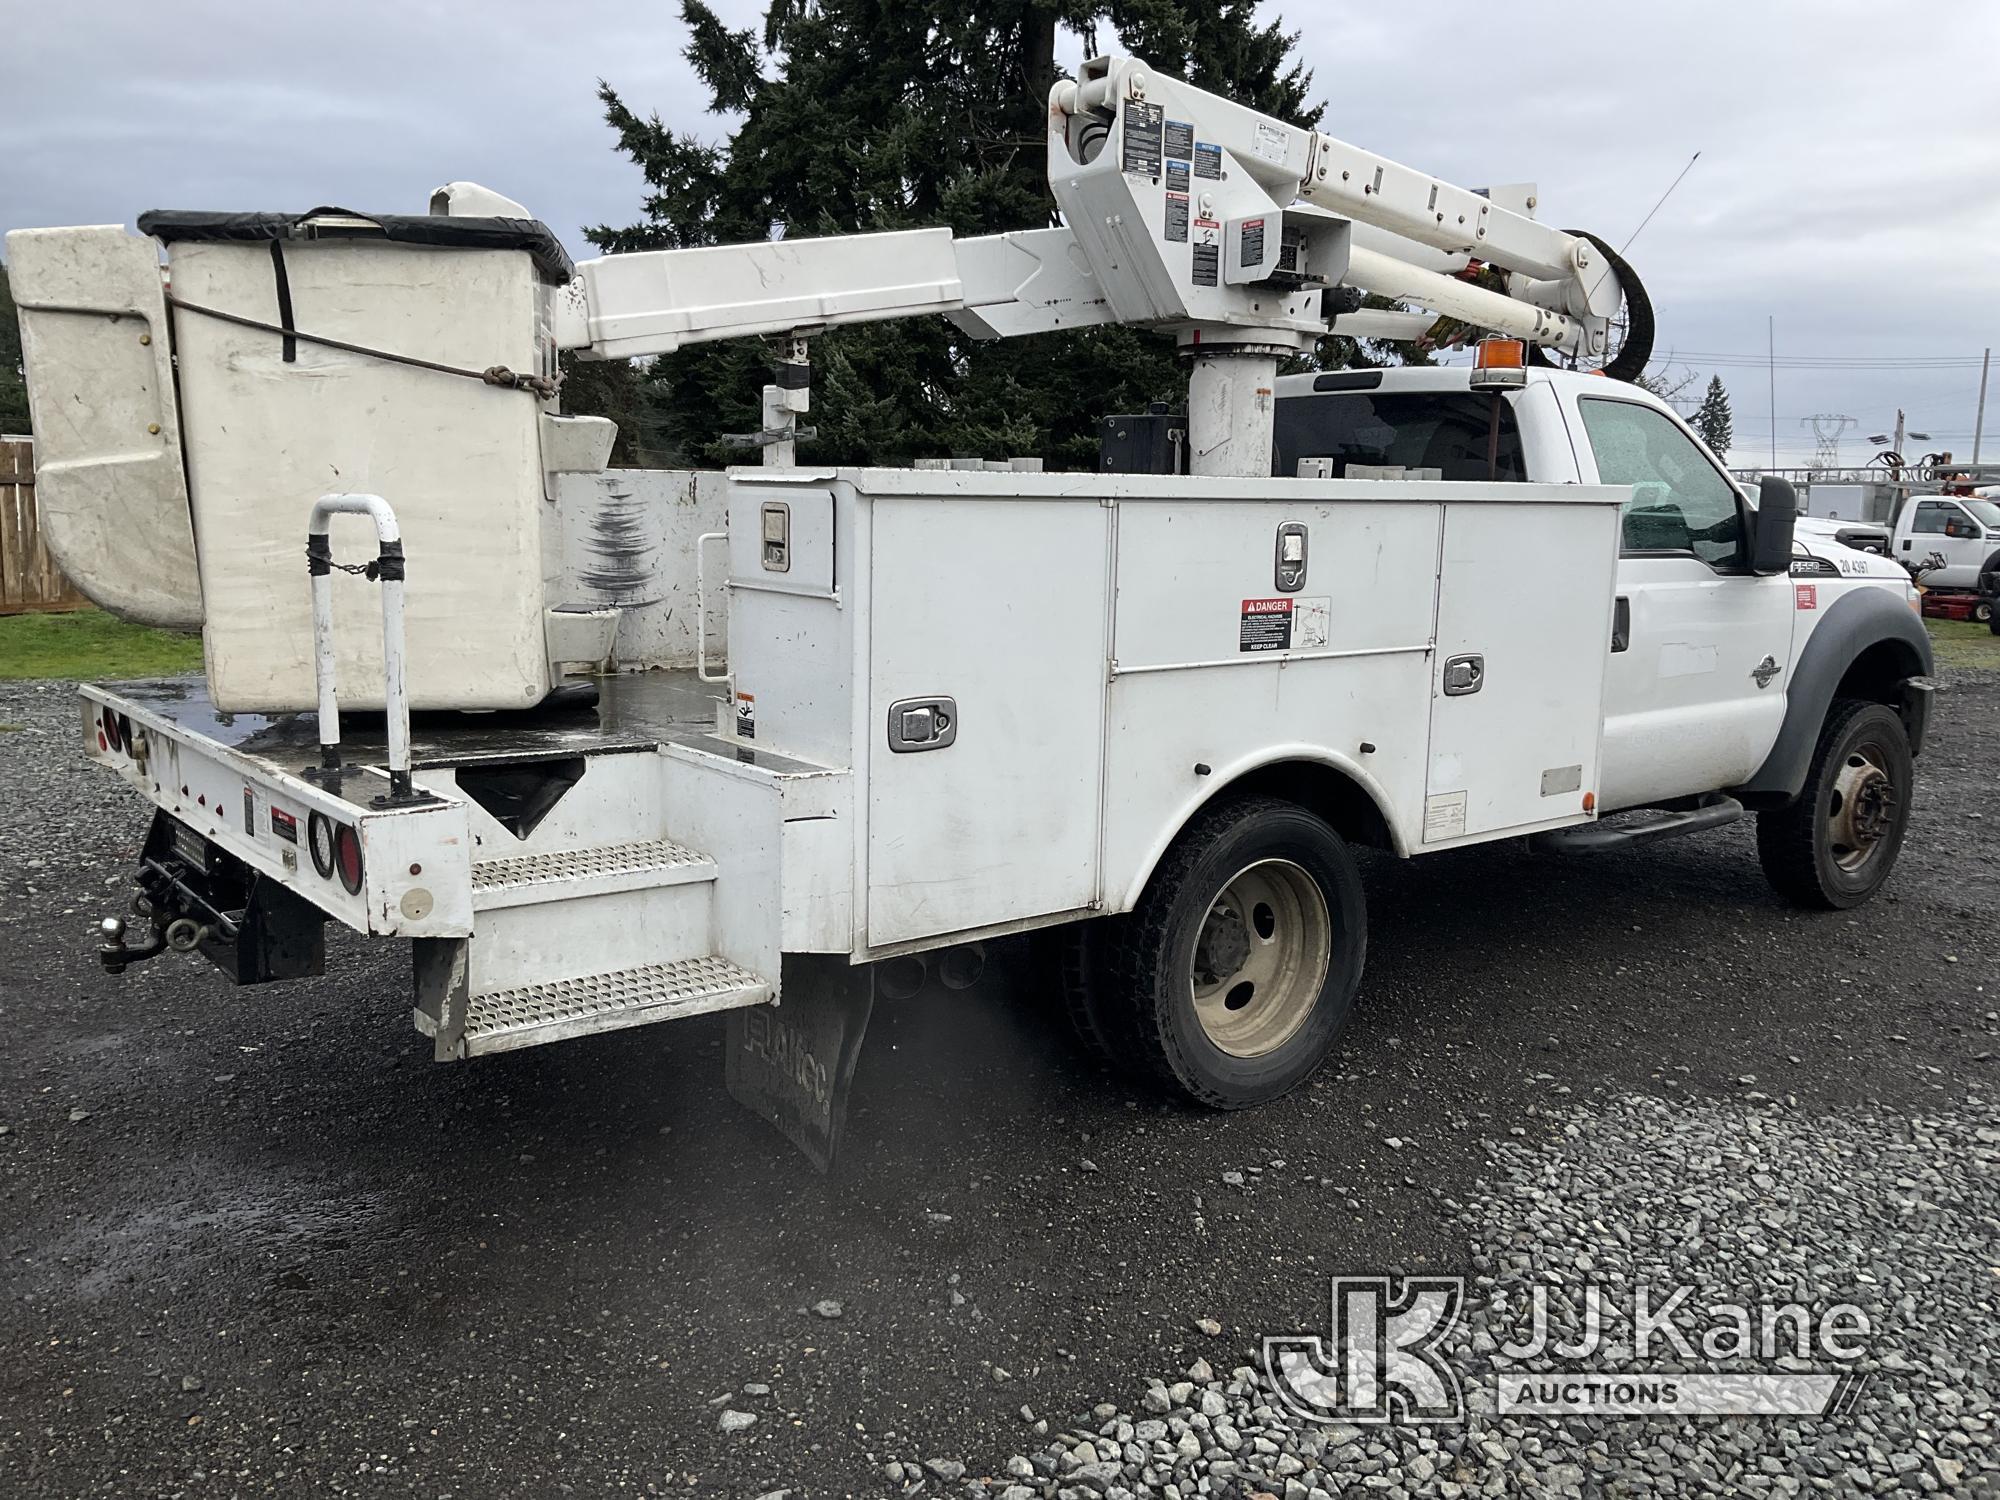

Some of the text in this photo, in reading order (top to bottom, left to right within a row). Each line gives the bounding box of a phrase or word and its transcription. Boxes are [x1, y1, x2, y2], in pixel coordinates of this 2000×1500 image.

[1840, 560, 1869, 573] 20 4397
[1256, 602, 1288, 611] DANGER
